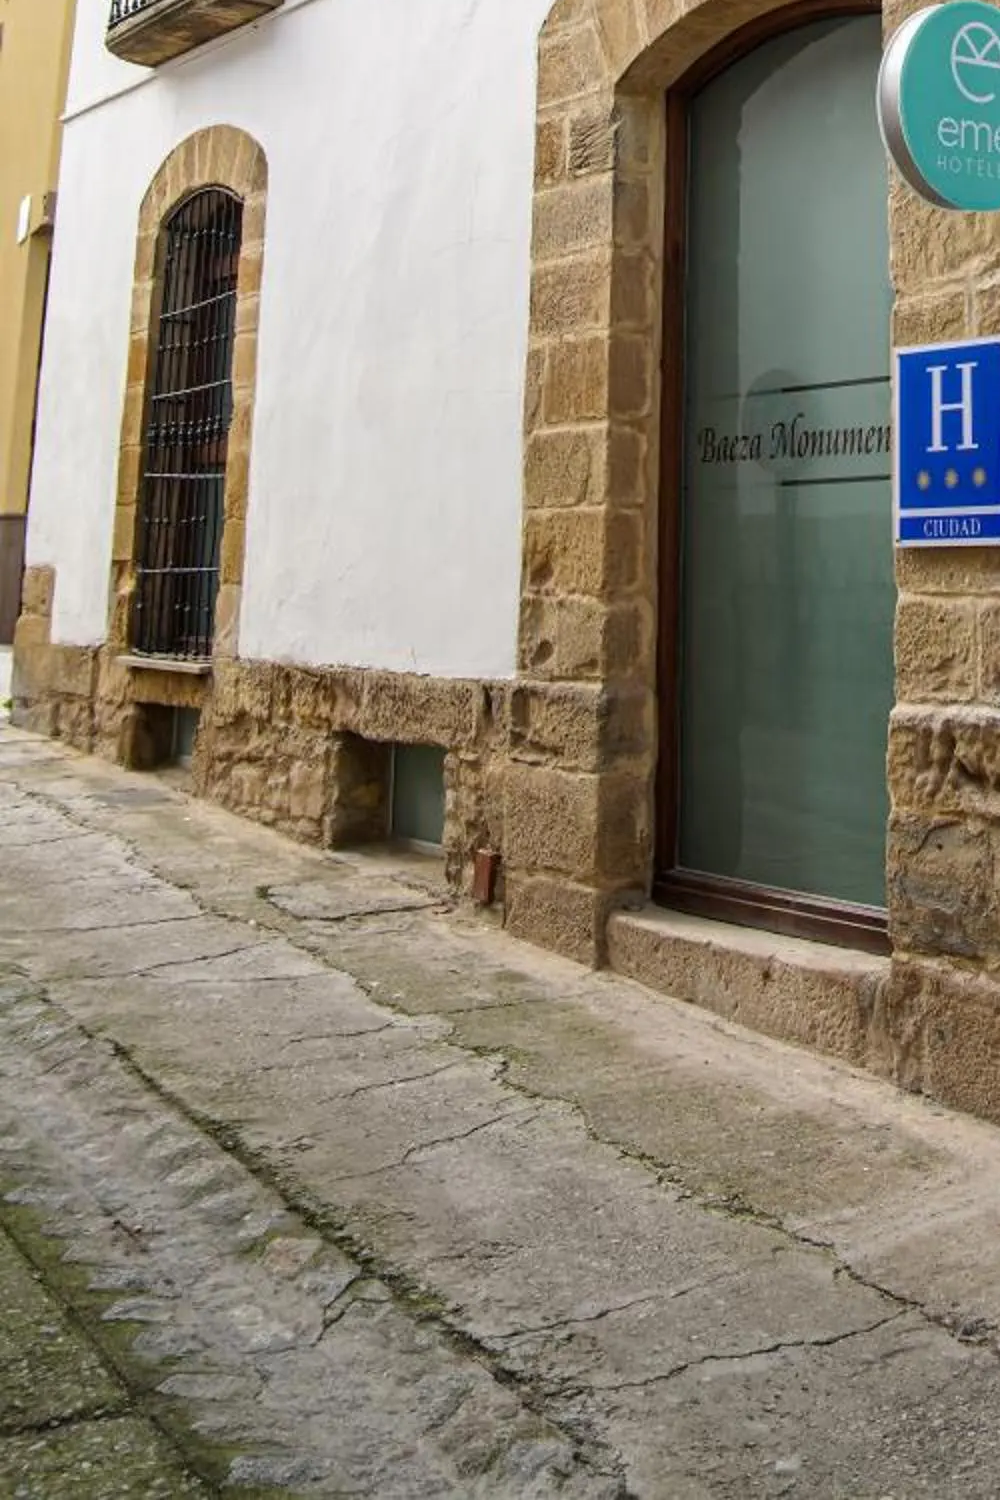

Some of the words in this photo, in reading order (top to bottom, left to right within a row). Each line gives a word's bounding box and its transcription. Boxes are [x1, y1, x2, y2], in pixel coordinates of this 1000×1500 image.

[925, 361, 979, 453] H
[700, 426, 762, 465] Baeza
[923, 518, 982, 538] CIUDAD
